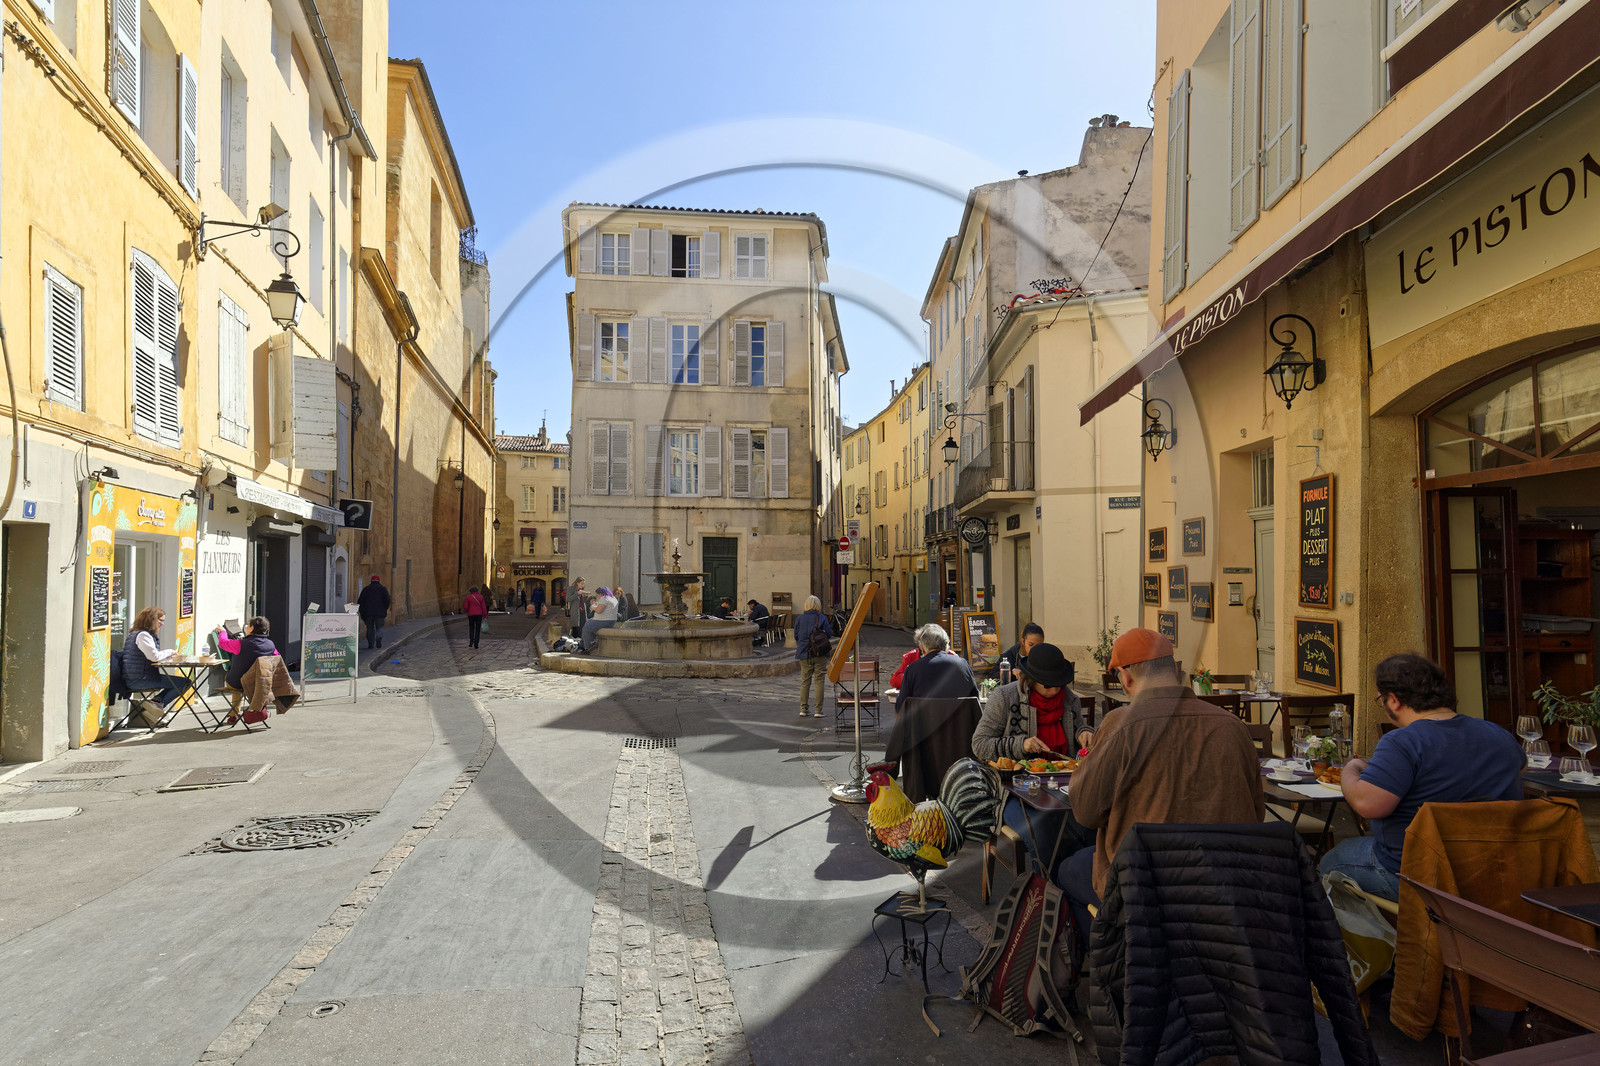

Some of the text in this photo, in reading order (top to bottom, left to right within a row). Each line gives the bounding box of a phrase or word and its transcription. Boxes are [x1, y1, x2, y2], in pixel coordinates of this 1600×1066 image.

[1397, 245, 1437, 295] LE
[1173, 280, 1249, 355] LE PISTON
[1303, 486, 1328, 503] FORMULE
[1305, 506, 1326, 526] PLAT
[215, 530, 230, 546] LES
[1309, 527, 1320, 537] PLUS
[1303, 538, 1329, 555] DESSERT
[202, 551, 242, 574] TANNEURS
[1308, 557, 1321, 566] PLUS
[315, 623, 334, 633] Sunny
[314, 650, 347, 660] FRUITSHAKE
